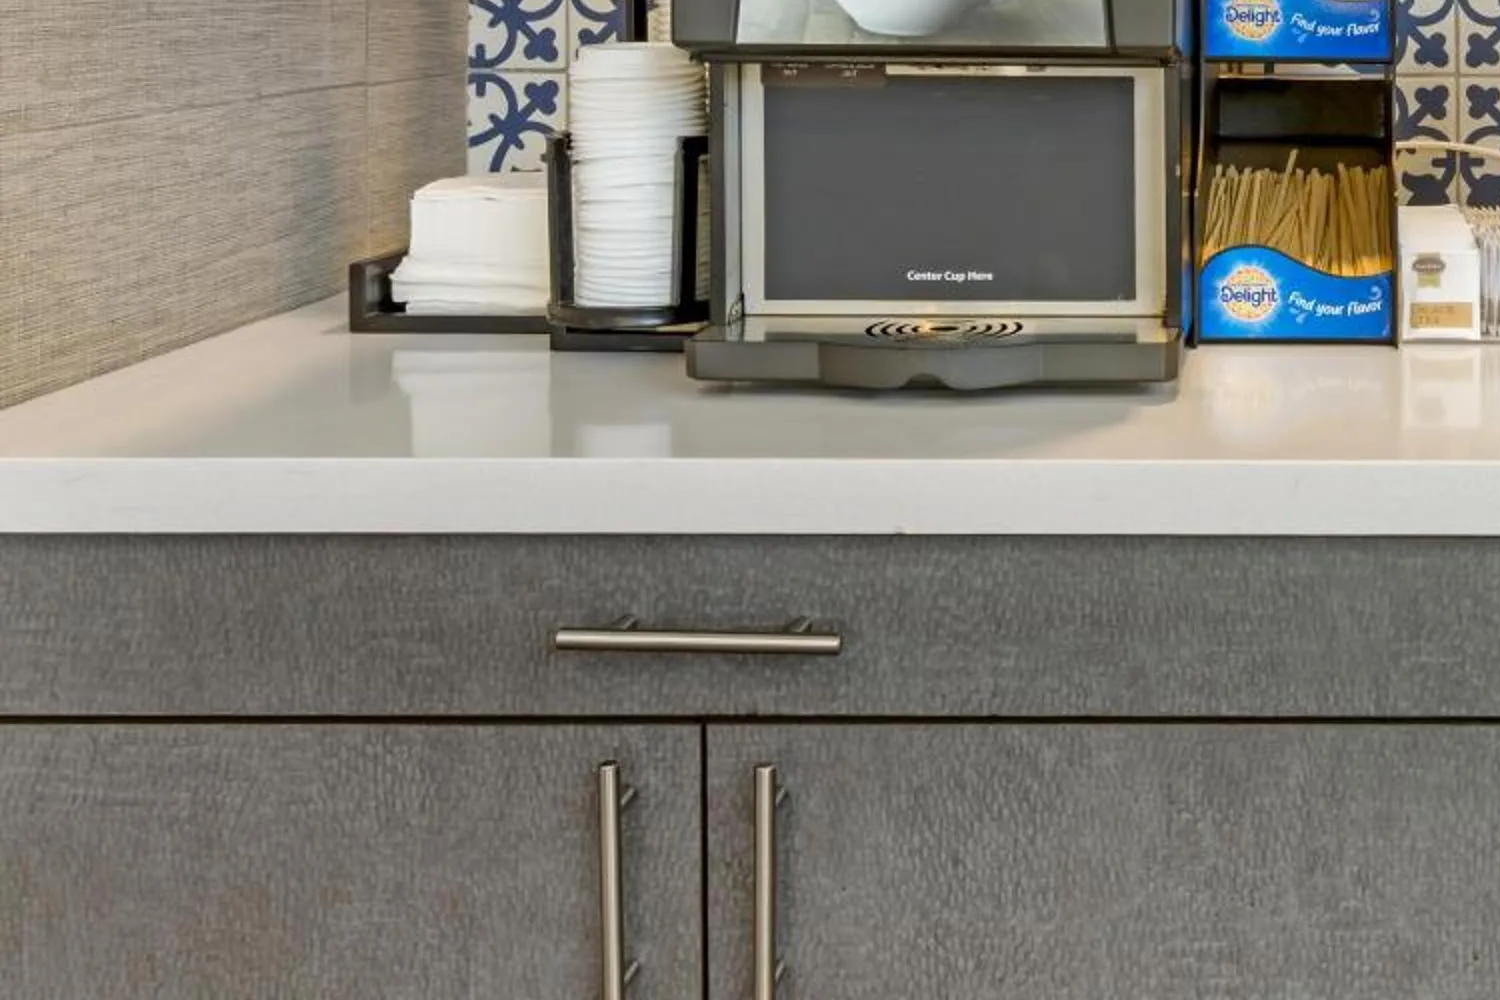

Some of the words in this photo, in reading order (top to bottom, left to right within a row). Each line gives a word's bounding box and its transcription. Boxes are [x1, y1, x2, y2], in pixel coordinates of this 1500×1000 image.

[1226, 6, 1281, 27] Delight
[1290, 12, 1317, 32] Find
[1316, 25, 1344, 37] your
[907, 270, 942, 281] Center
[944, 271, 966, 283] Cup
[967, 271, 993, 281] Here
[1221, 286, 1277, 307] Delight
[1288, 291, 1316, 311] Find
[1315, 303, 1345, 317] your
